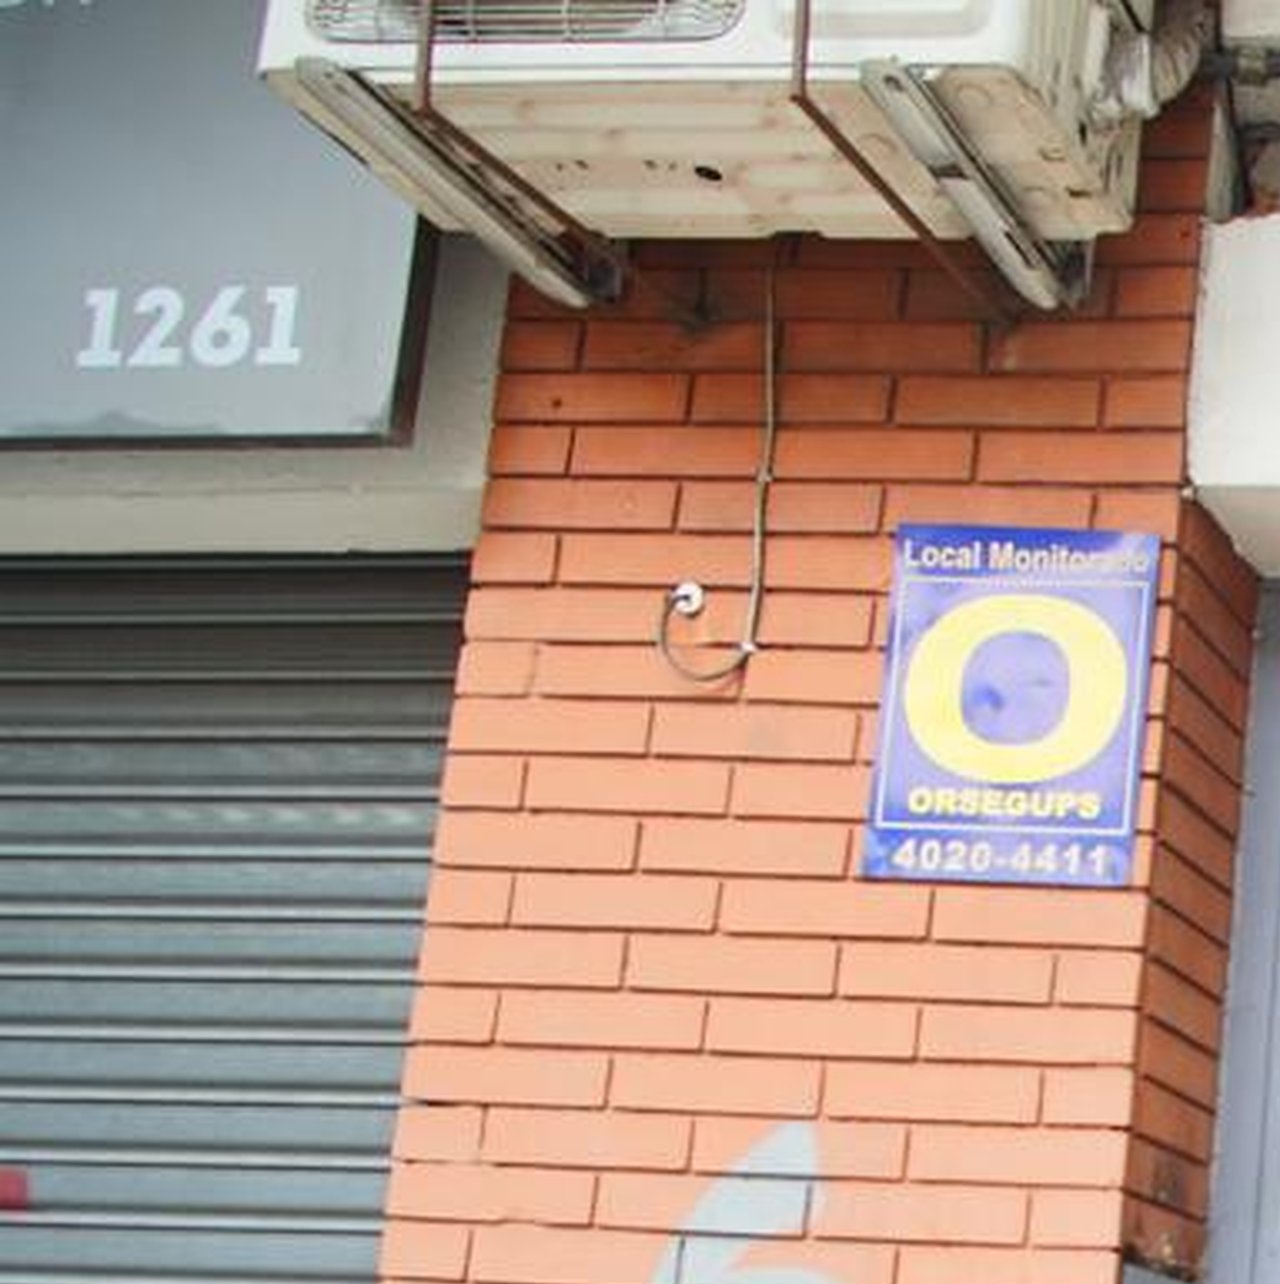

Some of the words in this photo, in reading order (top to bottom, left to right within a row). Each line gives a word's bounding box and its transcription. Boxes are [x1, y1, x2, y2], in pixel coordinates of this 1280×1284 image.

[75, 284, 303, 368] 1261
[903, 538, 981, 569] Local
[907, 786, 1102, 820] ORSEGUPS
[891, 837, 1112, 876] 4020-4411
